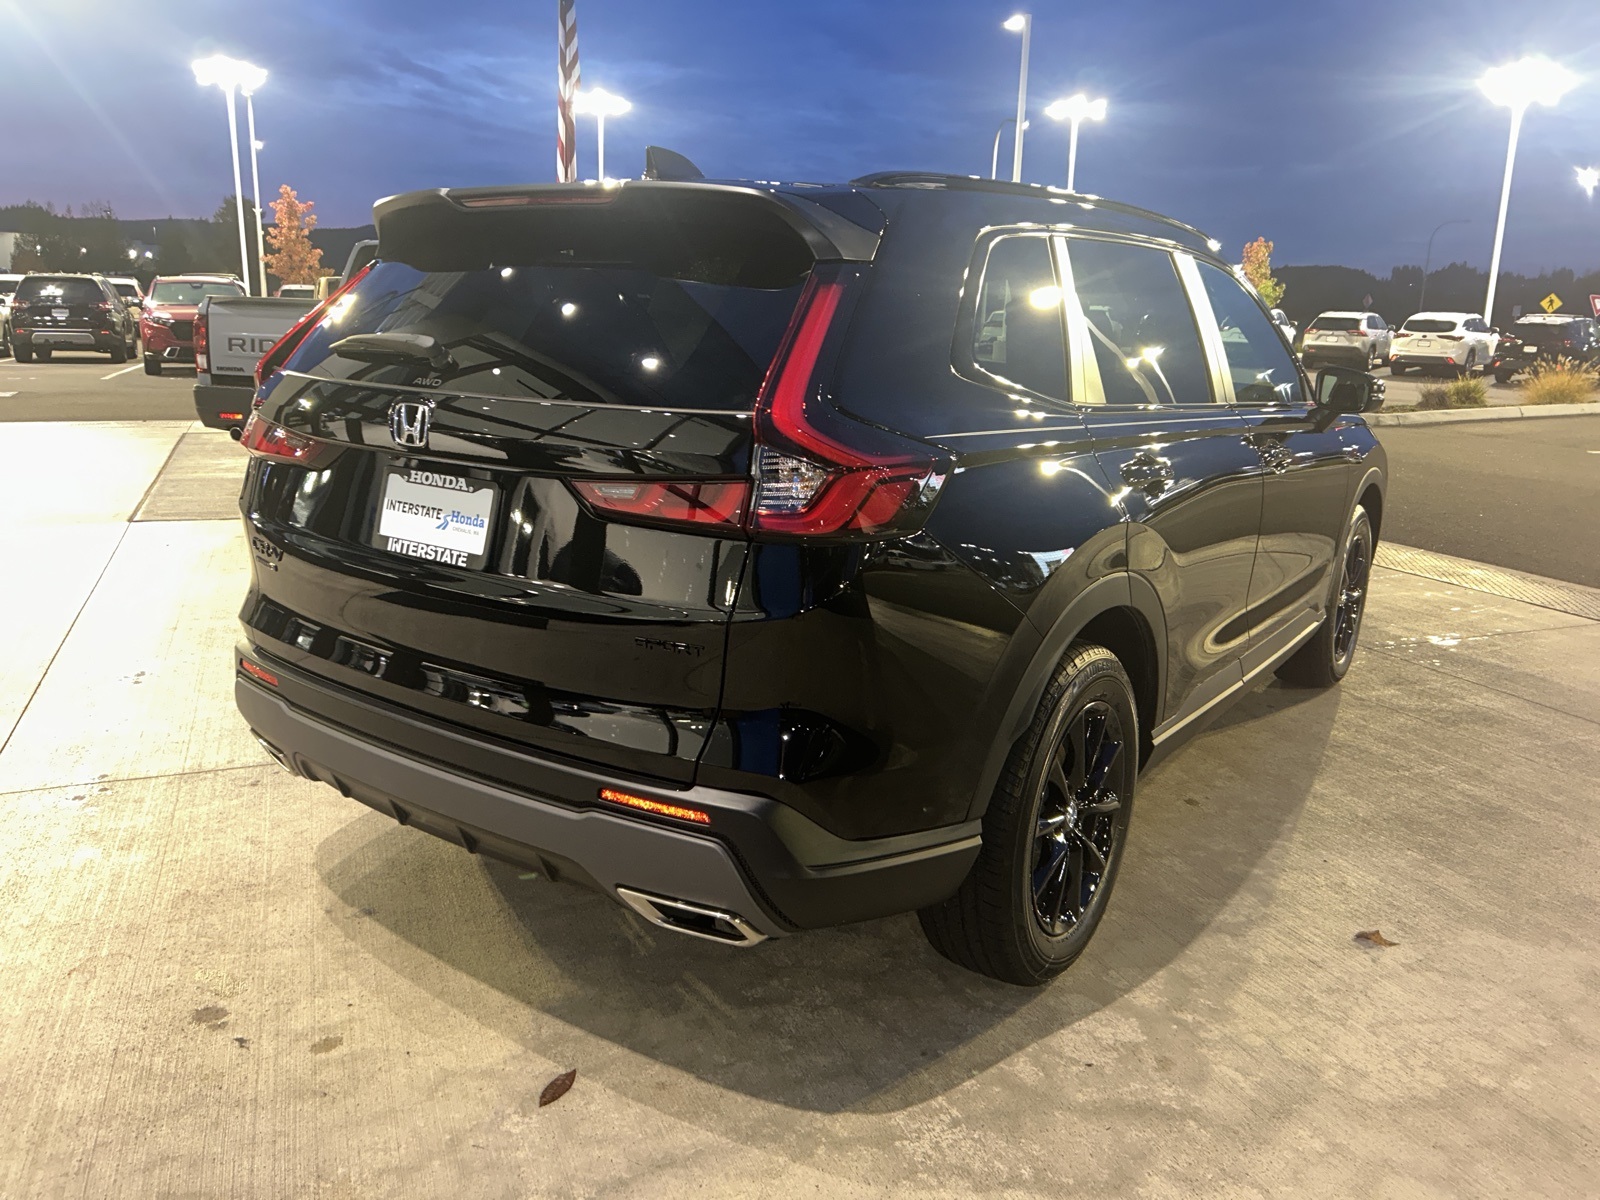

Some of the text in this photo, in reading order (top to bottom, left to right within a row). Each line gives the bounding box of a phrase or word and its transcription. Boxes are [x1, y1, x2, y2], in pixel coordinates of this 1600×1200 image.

[412, 377, 442, 387] AWD
[409, 470, 469, 491] HONDA
[386, 499, 443, 520] INTERSTATE
[450, 510, 485, 528] Honda
[387, 537, 469, 567] INTERSTATE
[635, 636, 705, 656] SPORT
